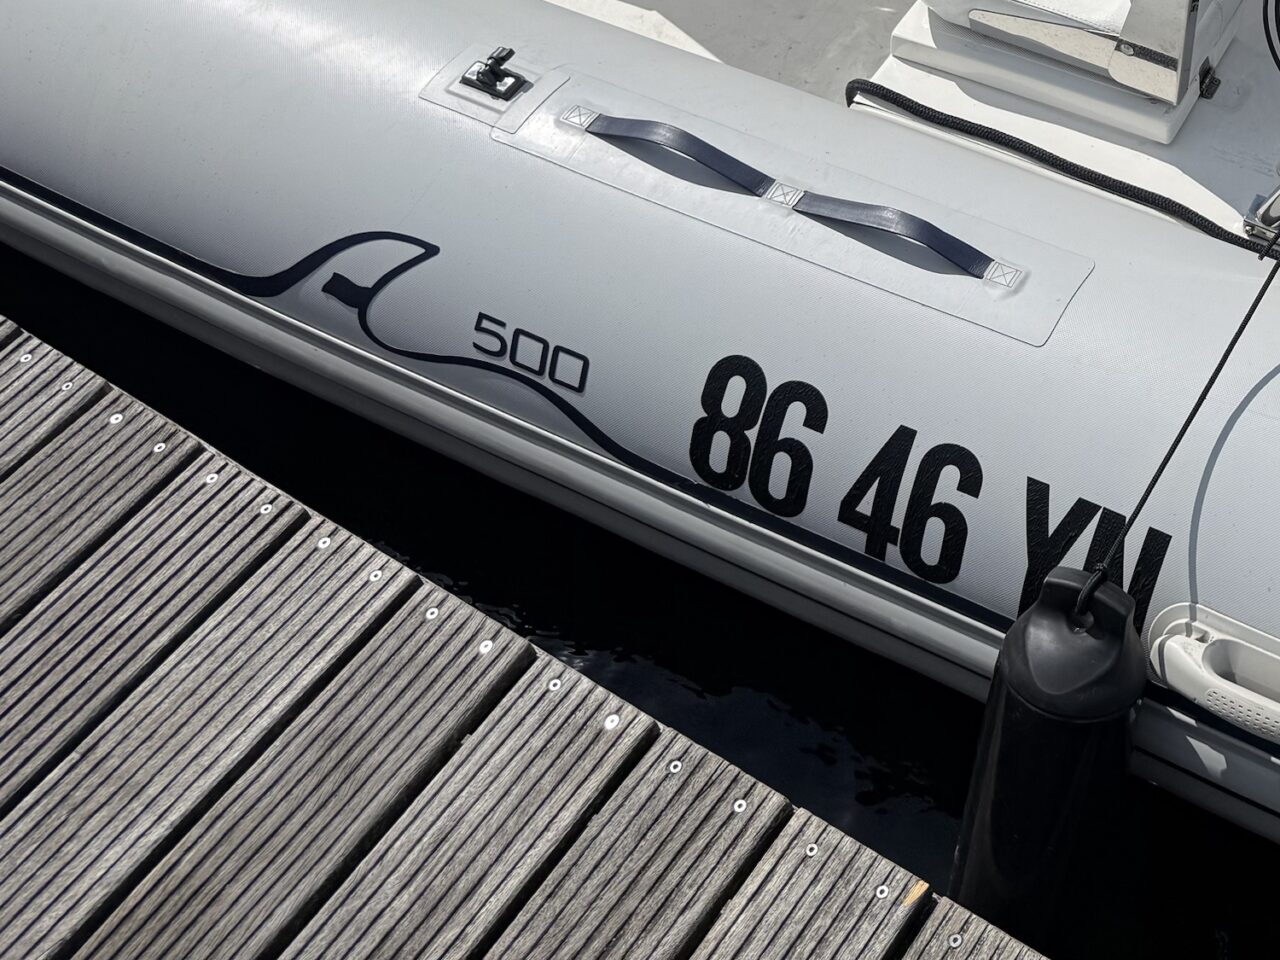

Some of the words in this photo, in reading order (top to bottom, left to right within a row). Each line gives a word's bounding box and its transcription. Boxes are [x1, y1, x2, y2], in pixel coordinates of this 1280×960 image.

[472, 311, 590, 394] 500
[689, 354, 829, 518] 86
[837, 424, 984, 585] 46
